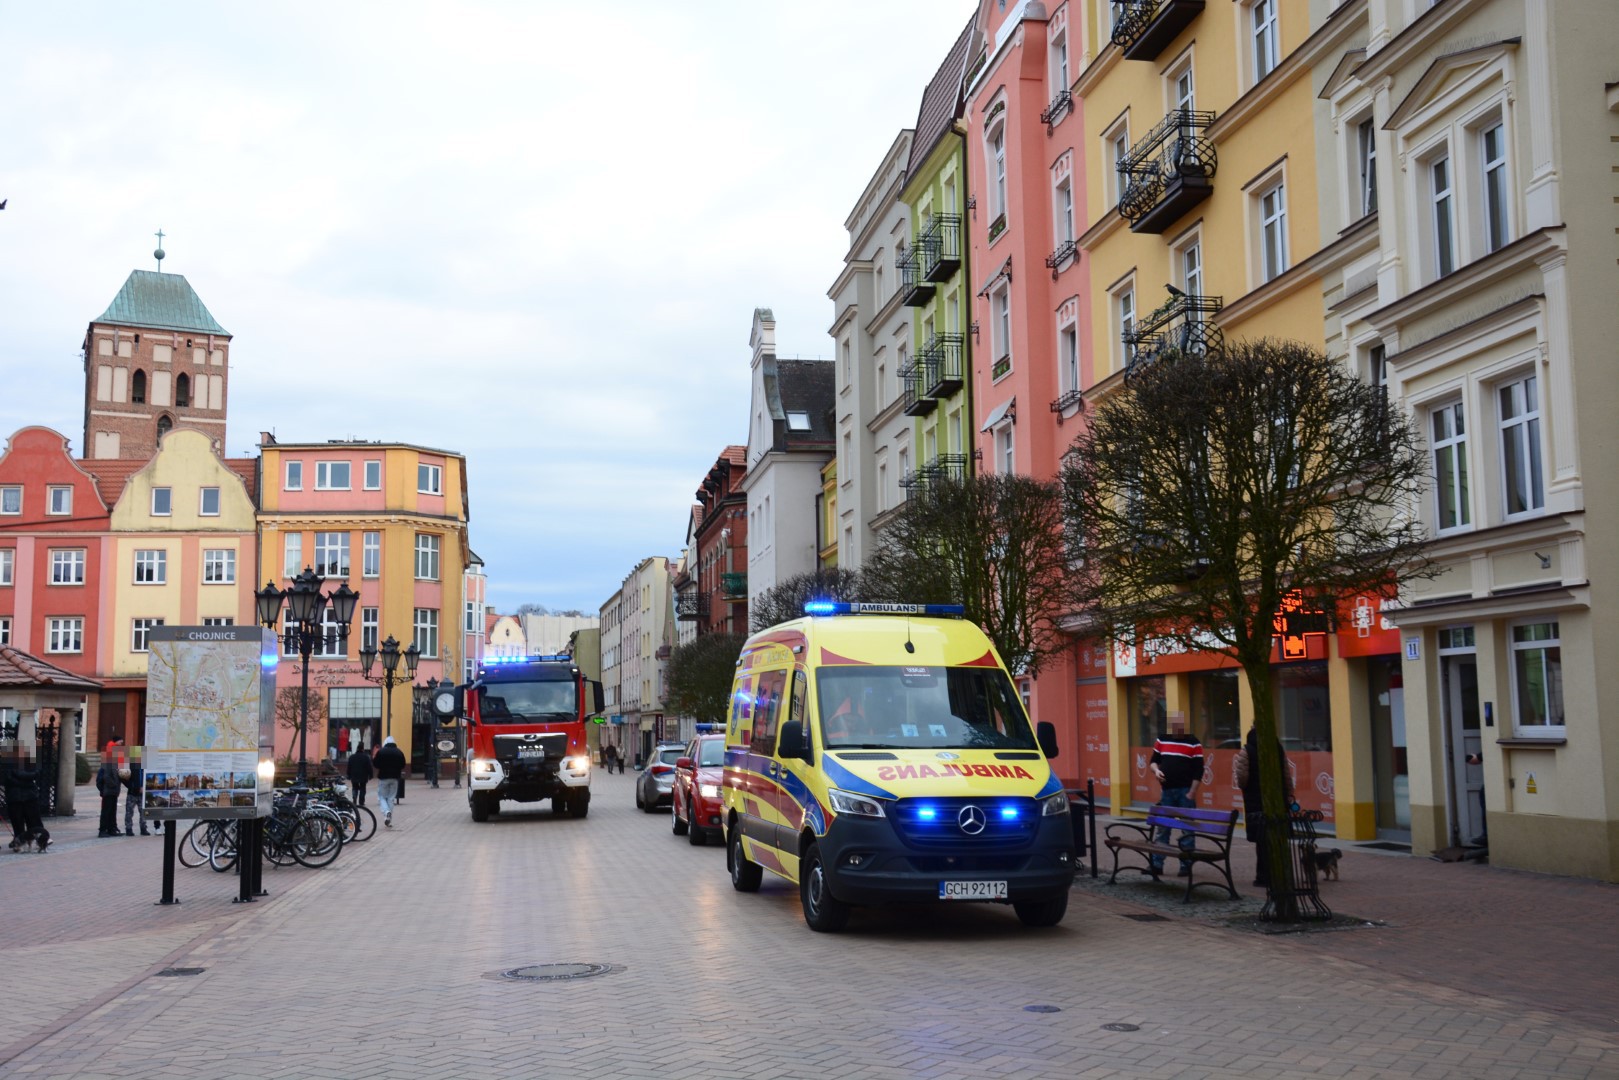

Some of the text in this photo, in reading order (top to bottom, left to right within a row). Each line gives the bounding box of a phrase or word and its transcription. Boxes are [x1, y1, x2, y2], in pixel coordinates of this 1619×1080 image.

[861, 604, 916, 612] AMBULANS
[189, 631, 236, 640] CHOJNICE
[1408, 643, 1417, 655] 11
[292, 664, 315, 674] Dm
[946, 882, 1007, 895] GCH 92112
